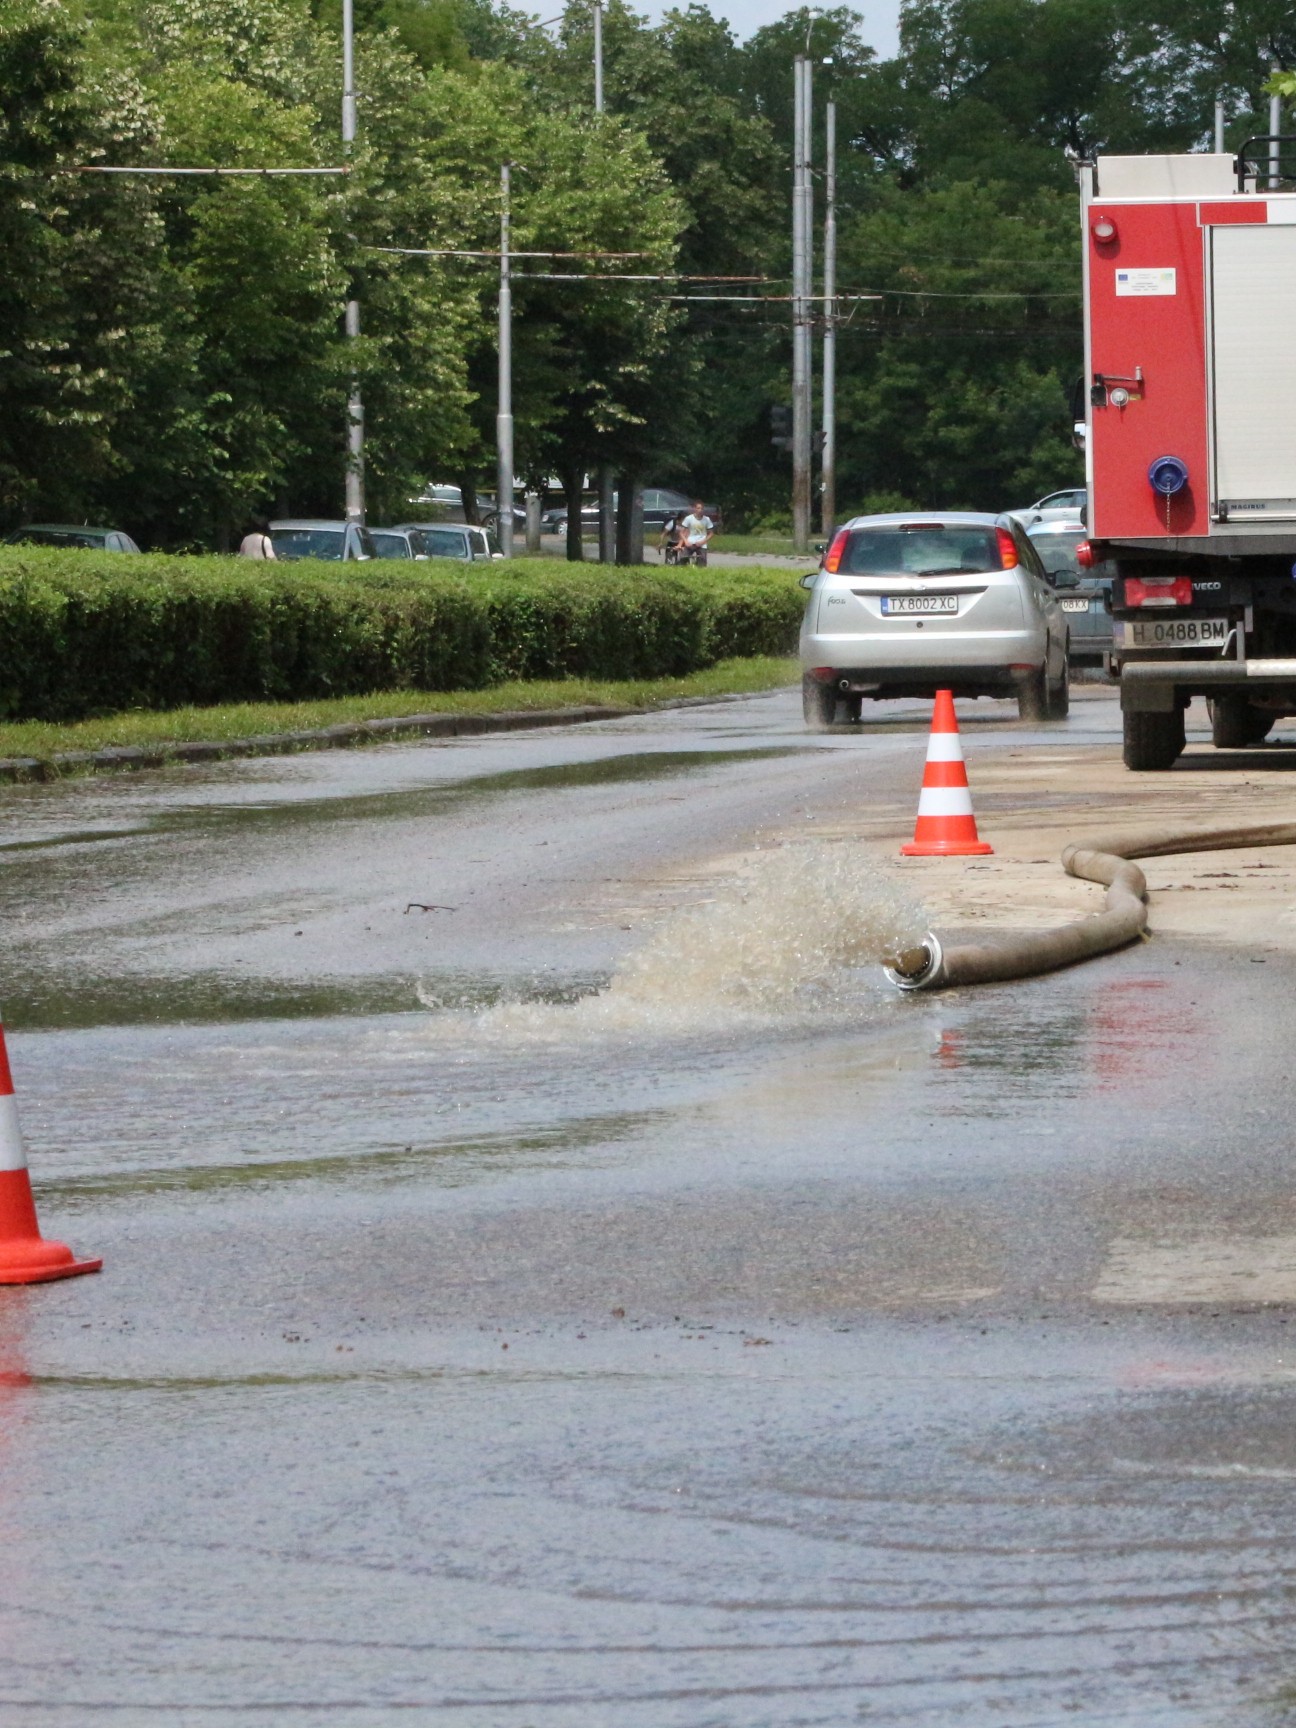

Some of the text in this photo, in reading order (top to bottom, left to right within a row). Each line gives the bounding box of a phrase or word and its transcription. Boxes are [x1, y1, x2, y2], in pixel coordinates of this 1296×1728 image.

[1191, 581, 1222, 590] IVECO
[890, 597, 955, 611] TX 8002 XC
[1063, 600, 1074, 609] 08
[1133, 622, 1225, 643] H 0488 BM
